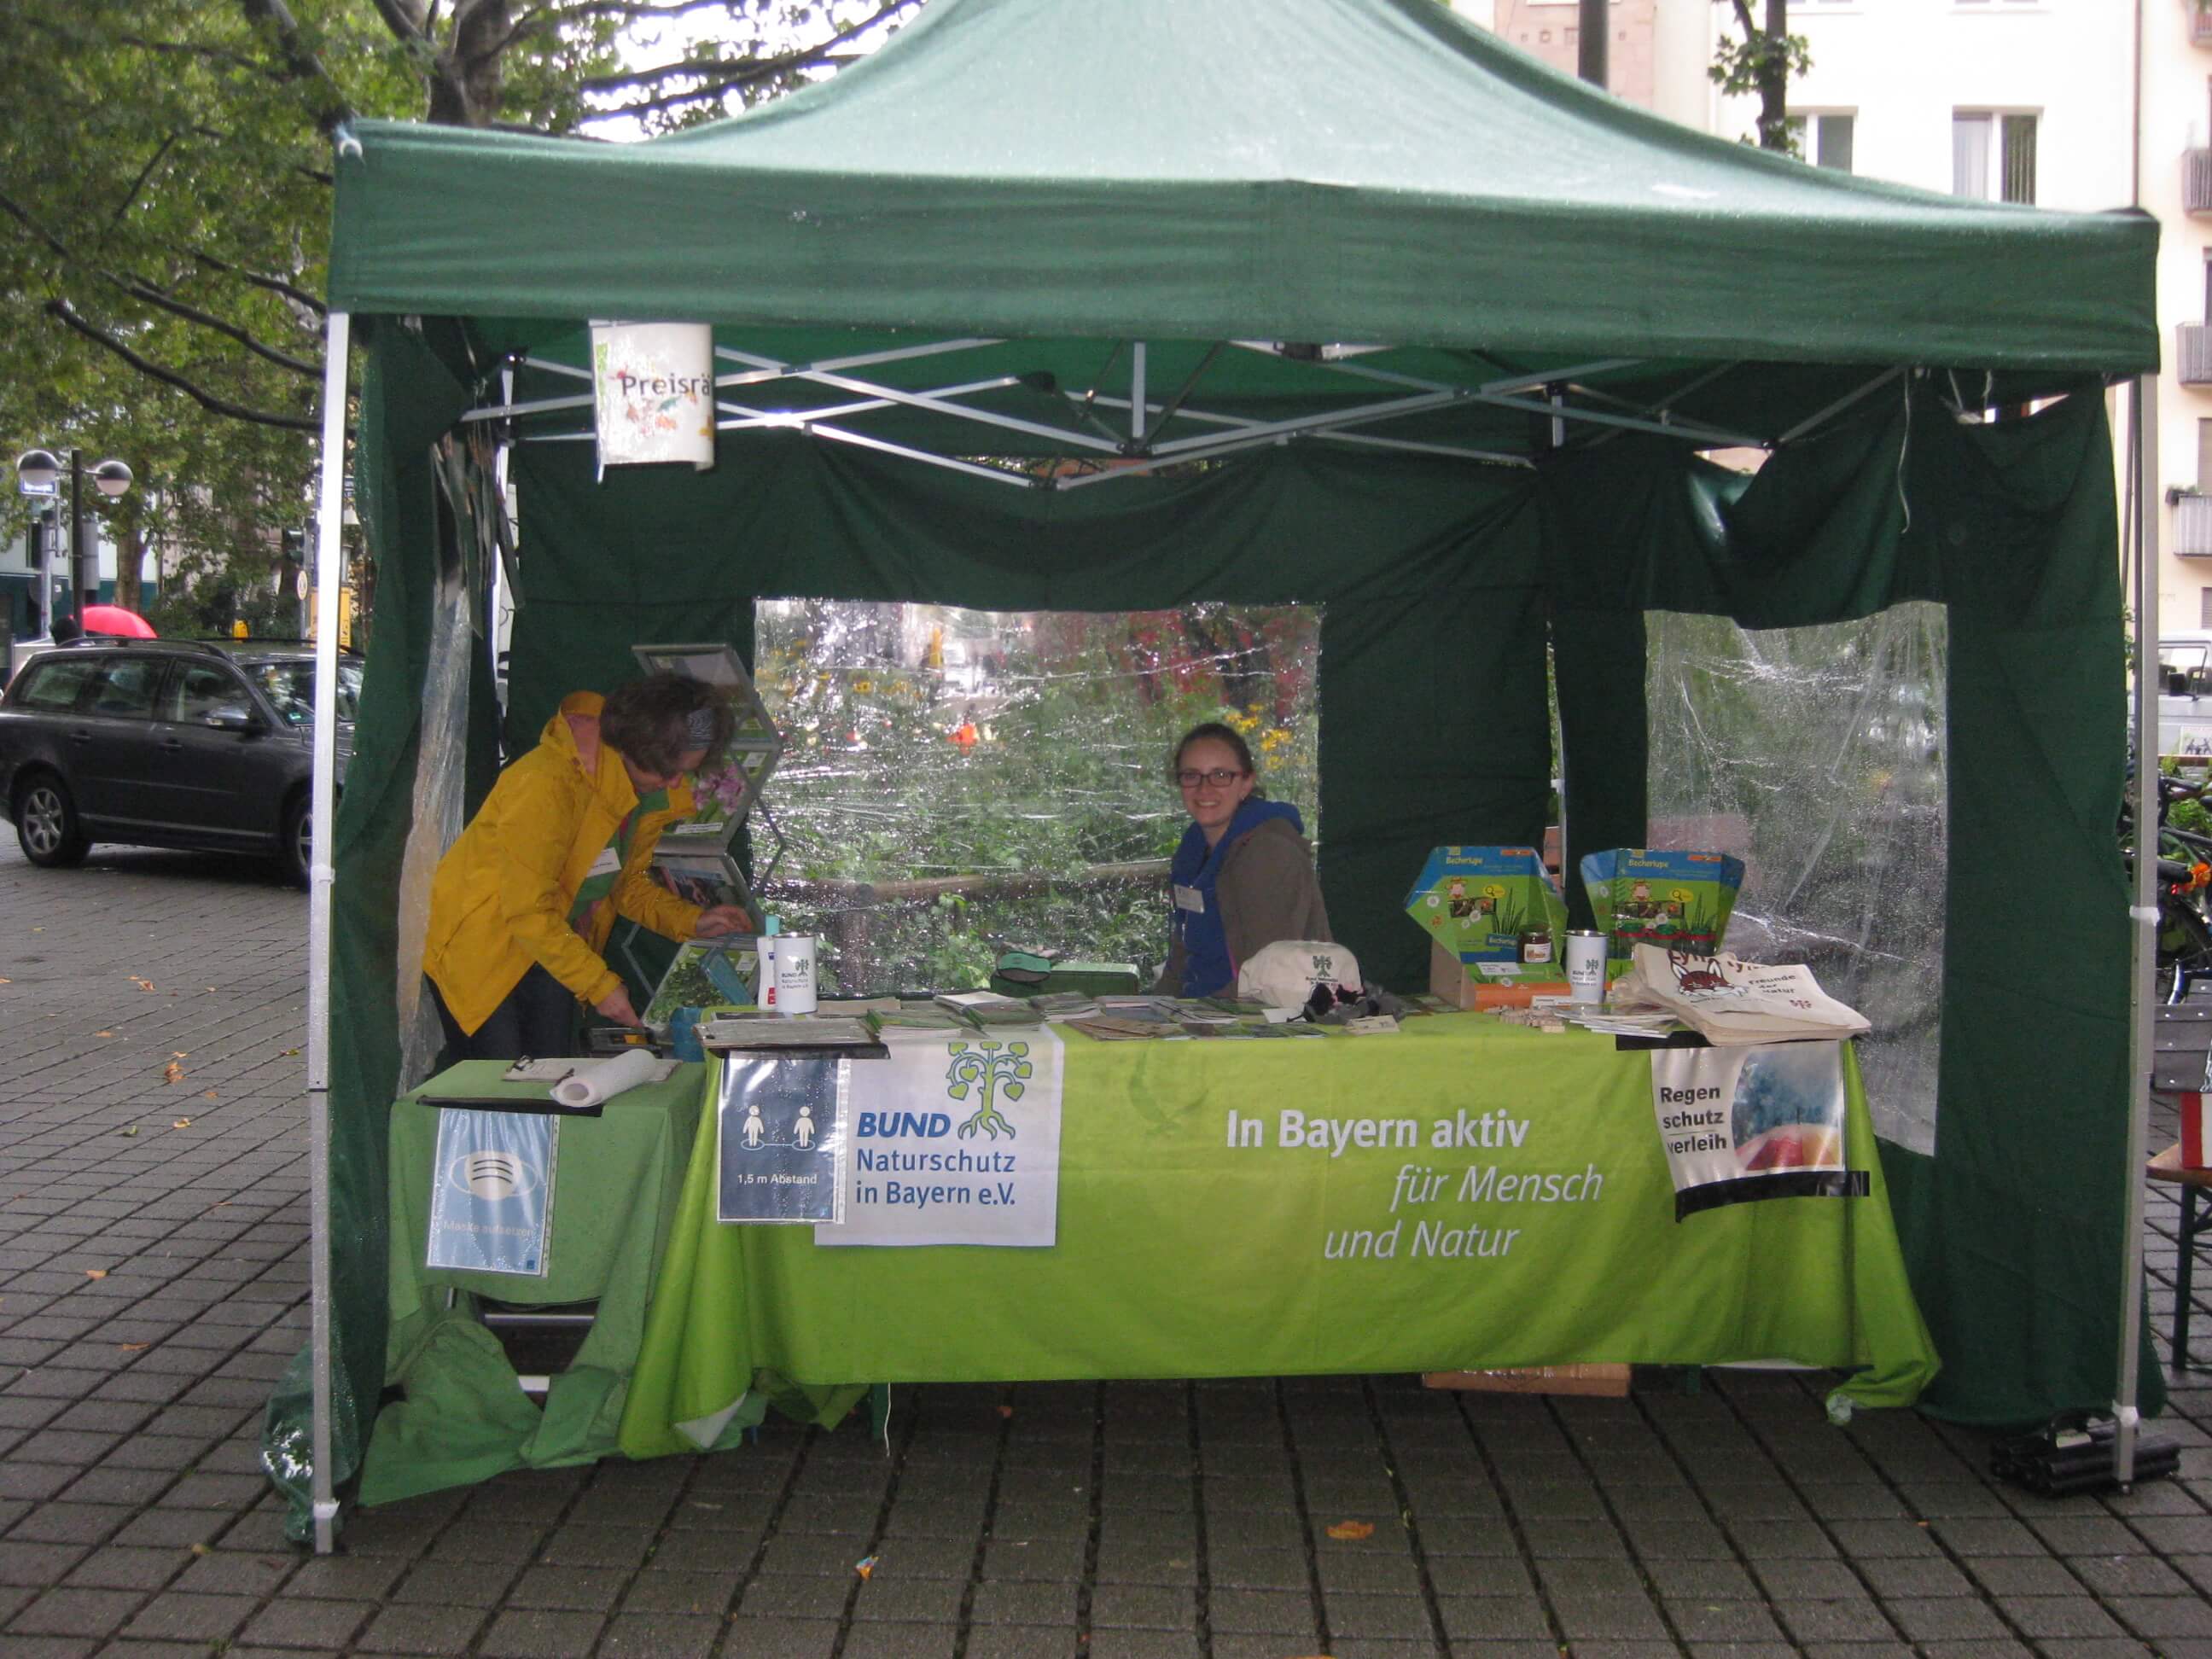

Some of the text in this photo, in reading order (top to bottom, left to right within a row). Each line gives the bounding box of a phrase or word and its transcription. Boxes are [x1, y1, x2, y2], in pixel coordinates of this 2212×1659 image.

[1748, 974, 1796, 986] Freunde
[1660, 1086, 1721, 1105] Regen
[856, 1111, 952, 1138] BUND
[1662, 1109, 1725, 1129] schutz
[1225, 1109, 1531, 1158] In Bayern aktiv
[1667, 1133, 1727, 1154] verleih
[856, 1148, 1016, 1173] Naturschutz
[736, 1173, 818, 1185] 1,5 m Abstand
[1388, 1162, 1604, 1214] für Mensch
[855, 1179, 1016, 1209] in Bayern e.V.
[443, 1220, 479, 1232] Maske
[1324, 1219, 1521, 1260] und Natur
